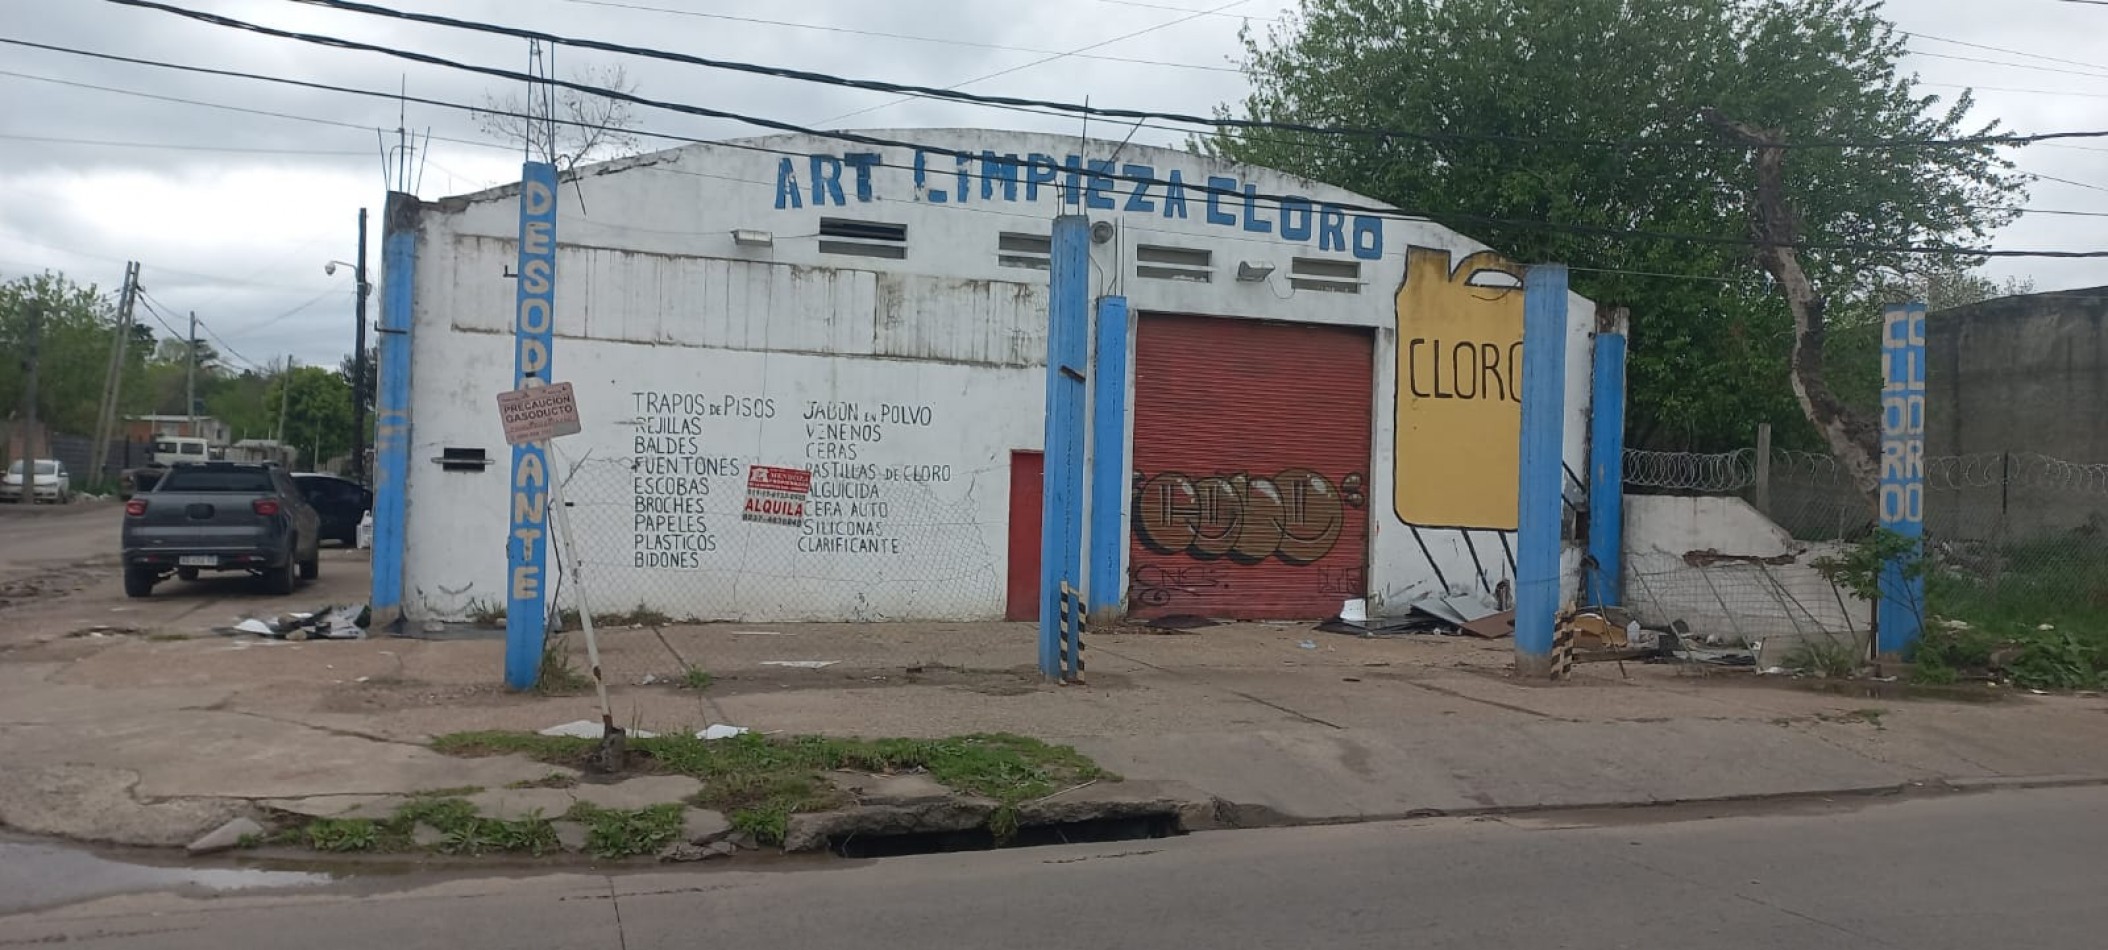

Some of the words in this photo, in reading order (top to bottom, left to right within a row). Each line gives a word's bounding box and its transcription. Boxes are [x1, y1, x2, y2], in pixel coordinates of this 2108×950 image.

[775, 152, 881, 209] ART
[914, 149, 1187, 219] LIMPIEZA
[1207, 176, 1382, 260] CLORO
[512, 180, 553, 600] DESODANTE
[505, 404, 573, 424] GASODUCTO
[632, 392, 705, 416] TRAPOS
[709, 404, 722, 416] DE
[724, 395, 776, 419] PISOS
[803, 401, 859, 421] JABON
[880, 403, 933, 426] POLVO
[1880, 310, 1909, 523] CLORO
[1904, 310, 1926, 523] CLORO
[635, 417, 702, 436] REJILLAS
[806, 423, 881, 442] VENENOS
[634, 436, 698, 455] BALDES
[805, 442, 857, 460] CERAS
[633, 456, 740, 476] FUENTONES
[805, 461, 876, 480] PASTILLAS
[885, 468, 900, 481] DE
[903, 464, 951, 482] CLORO
[634, 477, 710, 496] ESCOBAS
[634, 496, 705, 514] BROCHES
[744, 497, 803, 517] ALQUILA
[804, 501, 843, 517] CERA
[850, 501, 889, 518] AUTO
[634, 514, 707, 533] PAPELES
[803, 518, 884, 536] SILICONAS
[634, 534, 717, 551] PLASTICOS
[797, 536, 900, 554] CLARIFICANTE
[634, 551, 699, 569] BIDONES
